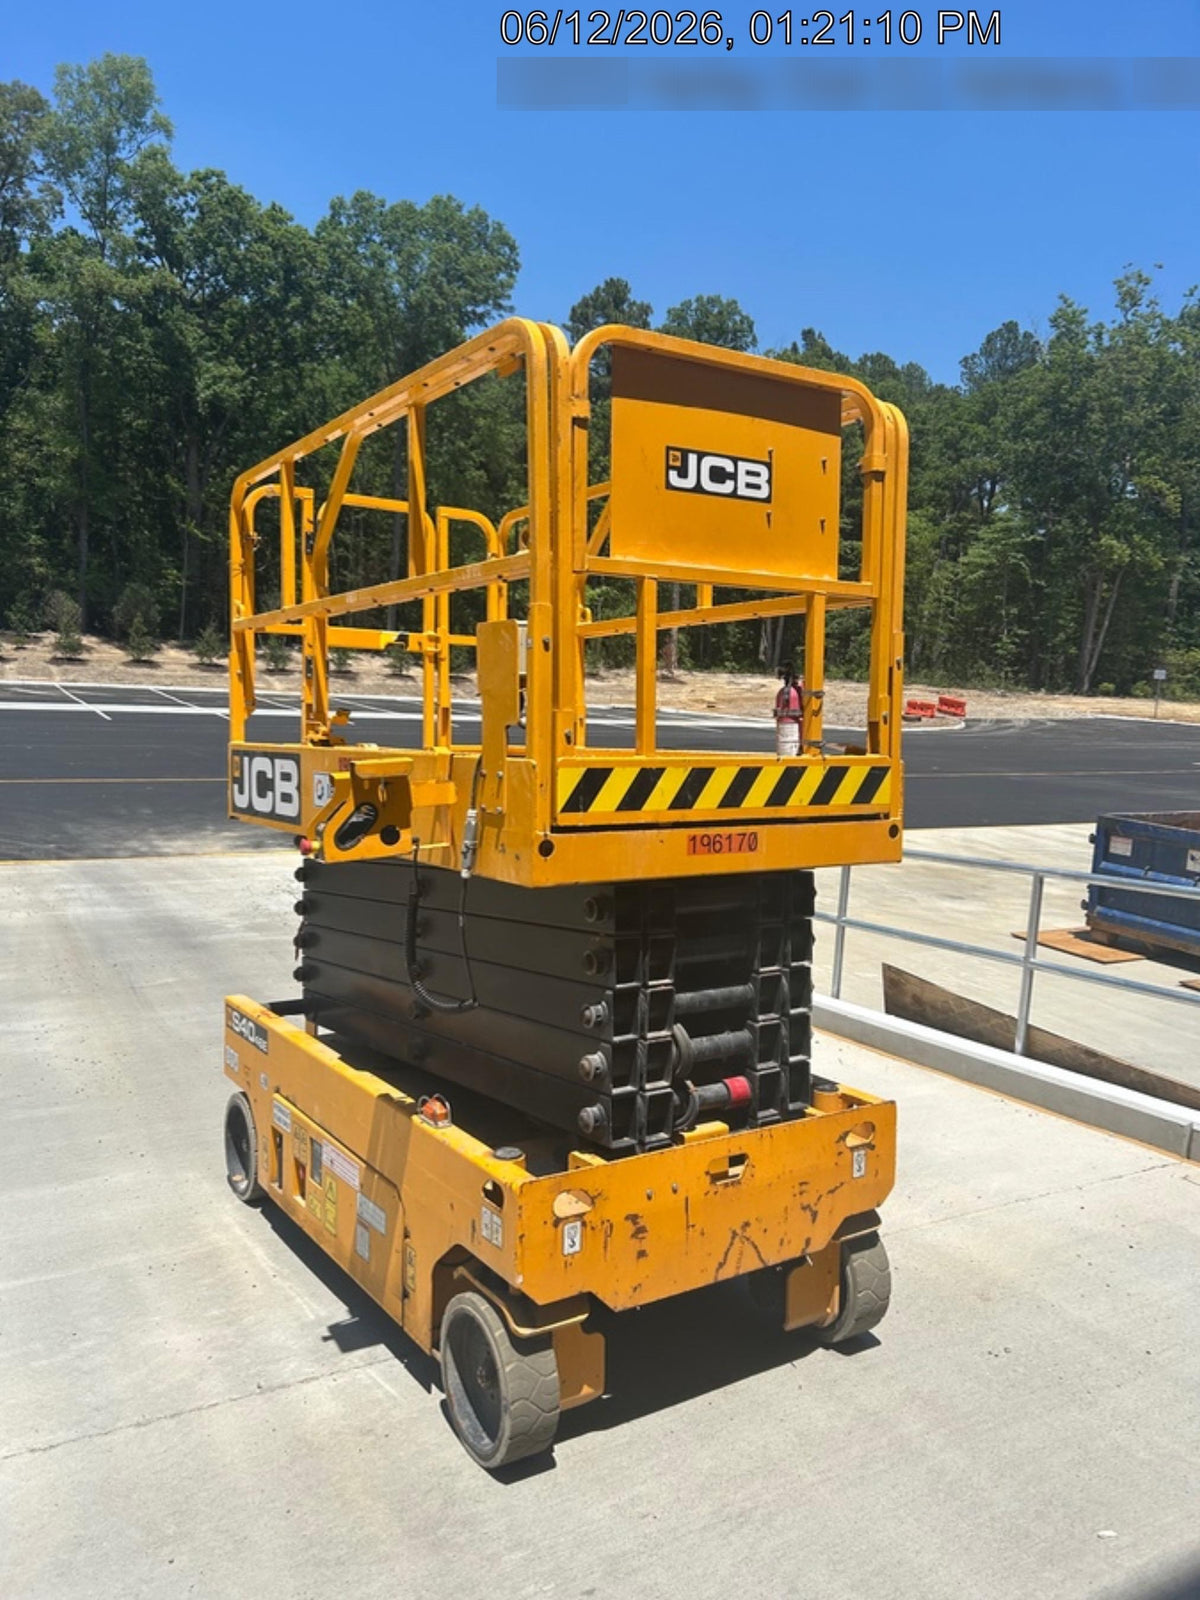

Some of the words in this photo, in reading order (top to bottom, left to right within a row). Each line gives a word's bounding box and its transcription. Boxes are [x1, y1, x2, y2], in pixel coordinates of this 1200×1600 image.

[668, 452, 770, 499] JCB
[233, 756, 299, 817] JCB
[688, 831, 759, 854] 196170
